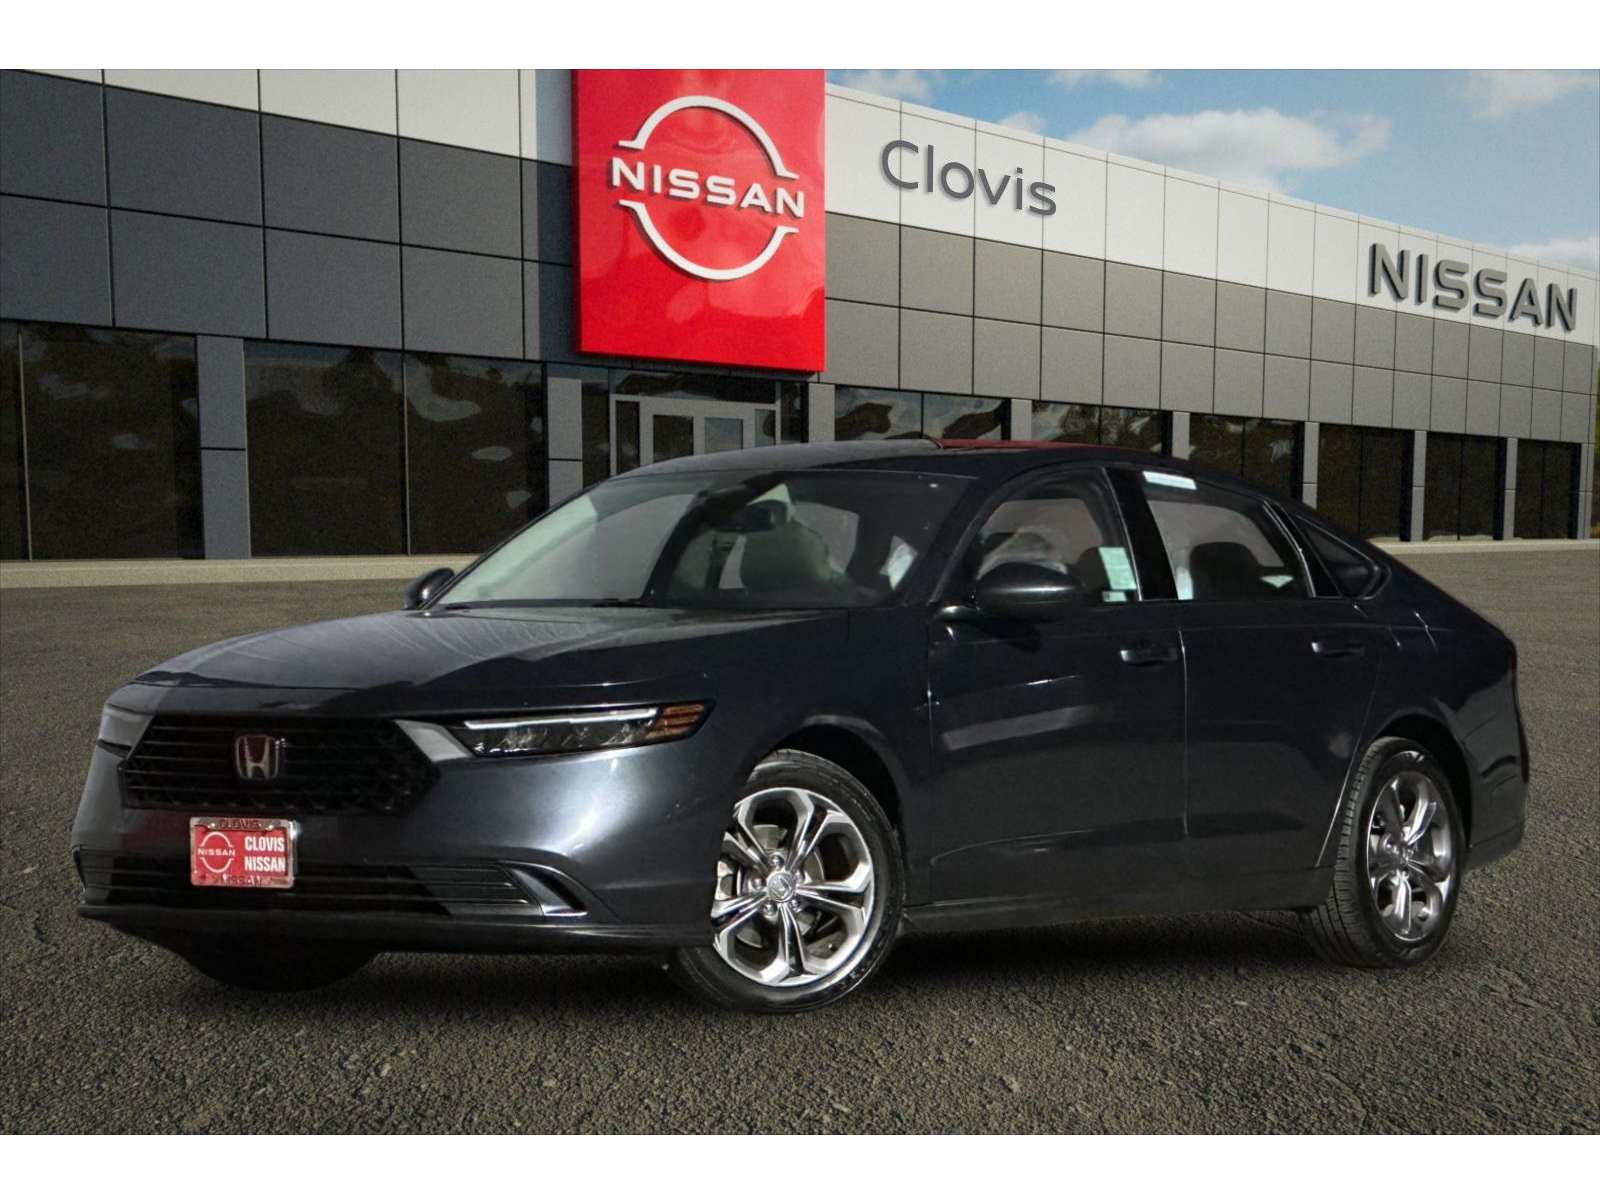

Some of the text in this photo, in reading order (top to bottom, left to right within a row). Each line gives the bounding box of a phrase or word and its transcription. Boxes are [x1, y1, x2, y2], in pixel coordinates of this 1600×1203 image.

[610, 157, 805, 218] NISSAN
[881, 140, 1057, 216] Clovis
[1368, 243, 1577, 332] NISSAN
[198, 848, 235, 857] NISSAN
[244, 836, 285, 852] CLOVIS
[244, 856, 286, 872] NISSAN
